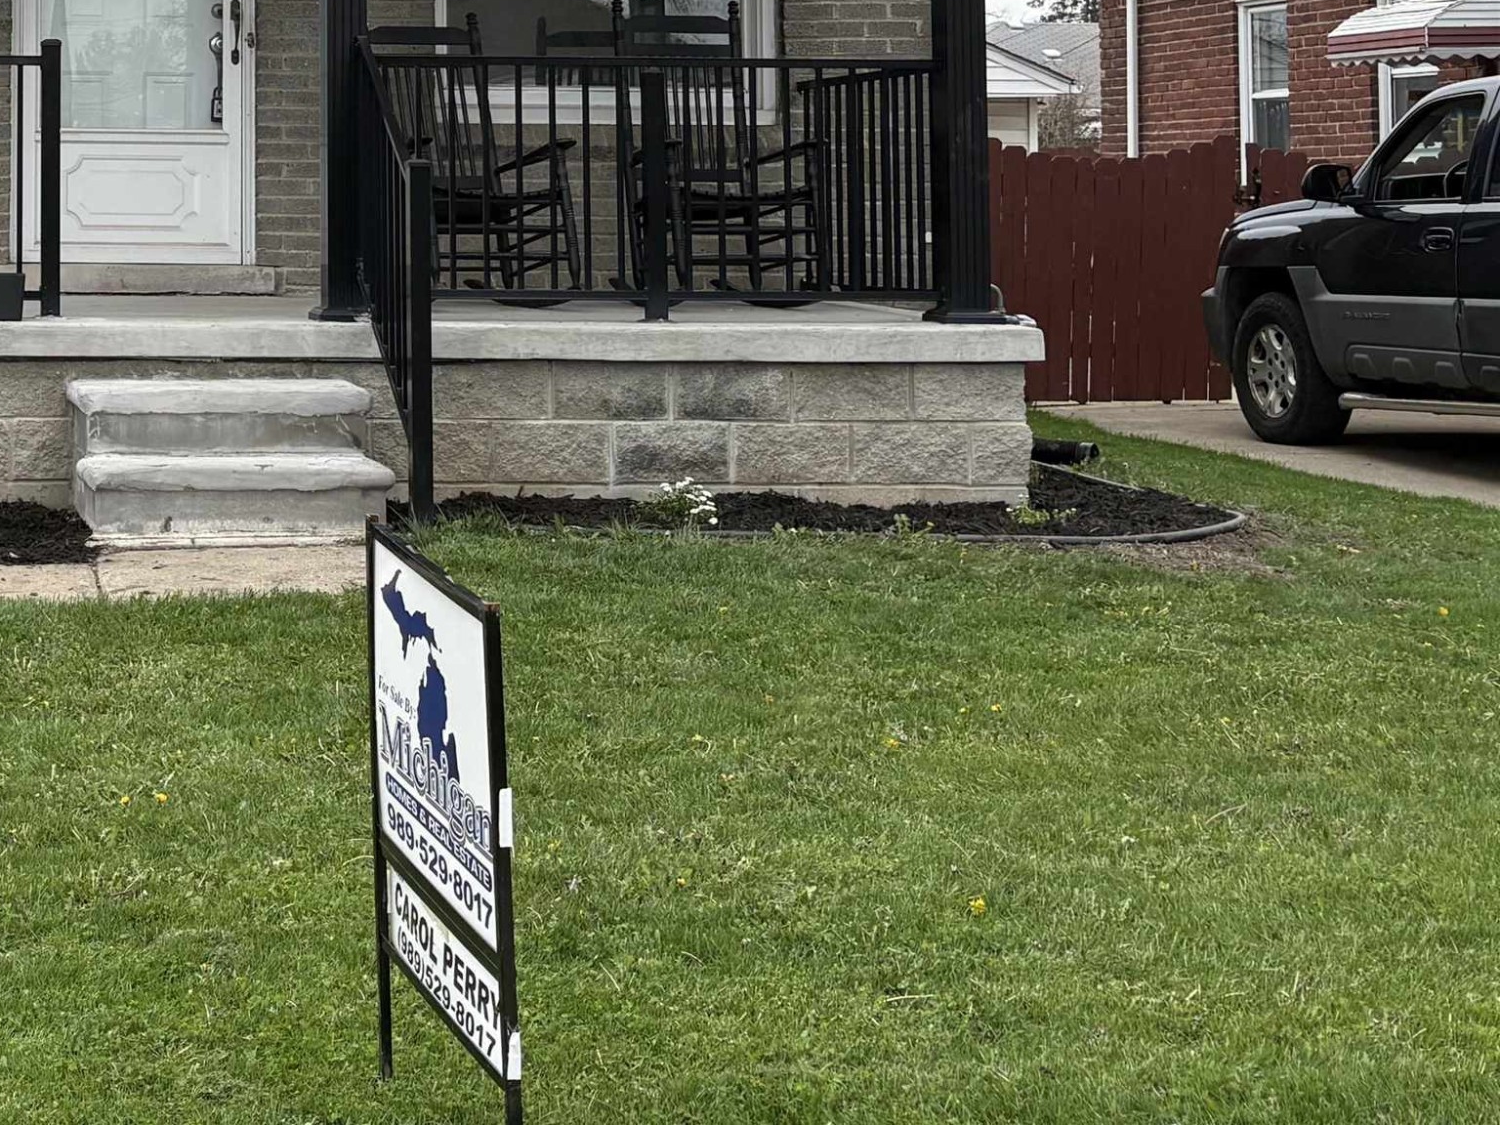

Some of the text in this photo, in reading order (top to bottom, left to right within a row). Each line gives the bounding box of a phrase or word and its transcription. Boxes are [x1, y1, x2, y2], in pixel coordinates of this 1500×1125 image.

[378, 674, 416, 720] For Sale By:
[379, 700, 491, 852] Michigan
[387, 776, 418, 817] HOMES
[428, 817, 453, 851] REAL
[453, 845, 491, 887] ESTATE
[395, 882, 501, 1031] CAROL PERRY
[397, 926, 497, 1058] (989)529-8017
